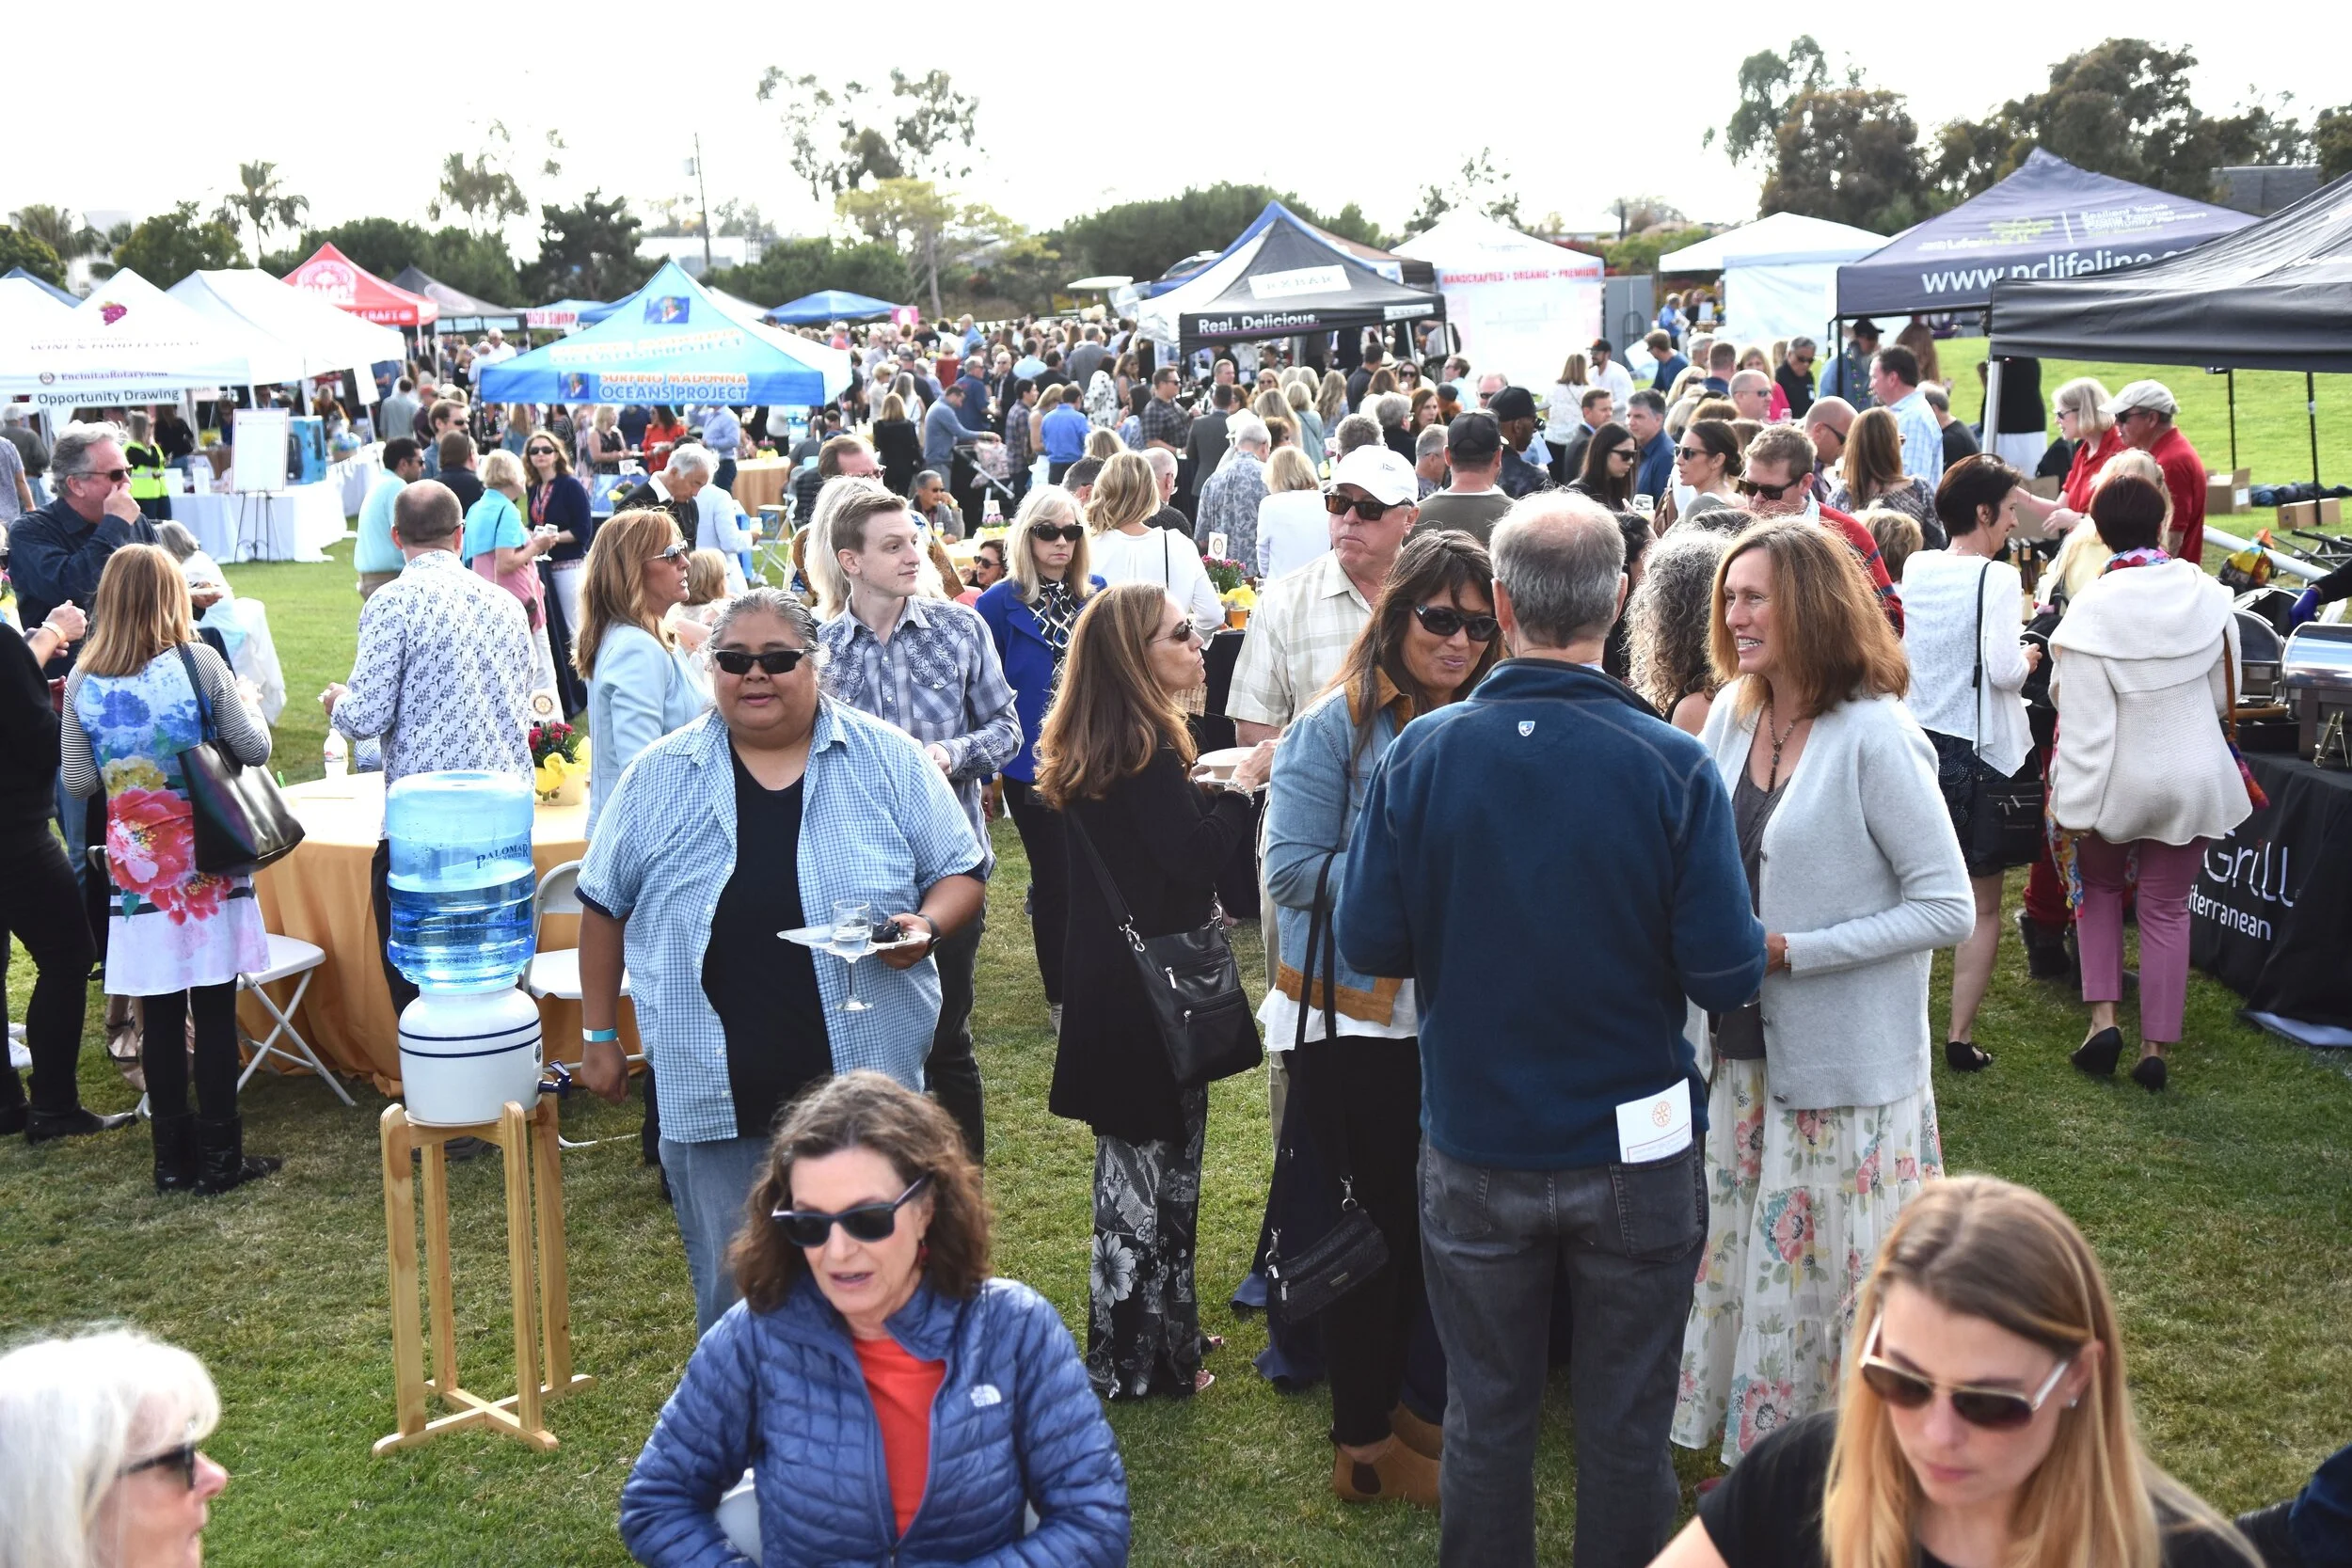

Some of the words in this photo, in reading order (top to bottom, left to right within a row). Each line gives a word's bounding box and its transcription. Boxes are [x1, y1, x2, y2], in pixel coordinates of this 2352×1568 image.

[1443, 272, 1504, 285] HANDCRAFTED
[1513, 270, 1549, 281] ORGANIC
[1559, 267, 1598, 279] PREMIUM
[1921, 249, 2179, 293] wwwnclifelin
[1198, 317, 1237, 334] Real.
[1242, 312, 1320, 330] Delicious.
[61, 370, 167, 381] EncinitasRotary.com
[600, 374, 662, 384] SURFING
[668, 373, 747, 385] MADONNA
[38, 389, 120, 406] Opportunity
[124, 387, 180, 402] Drawing
[601, 385, 670, 400] OCEANS
[675, 385, 747, 400] PROJECT
[475, 844, 529, 870] PALOMAR
[2186, 884, 2272, 941] iterranean
